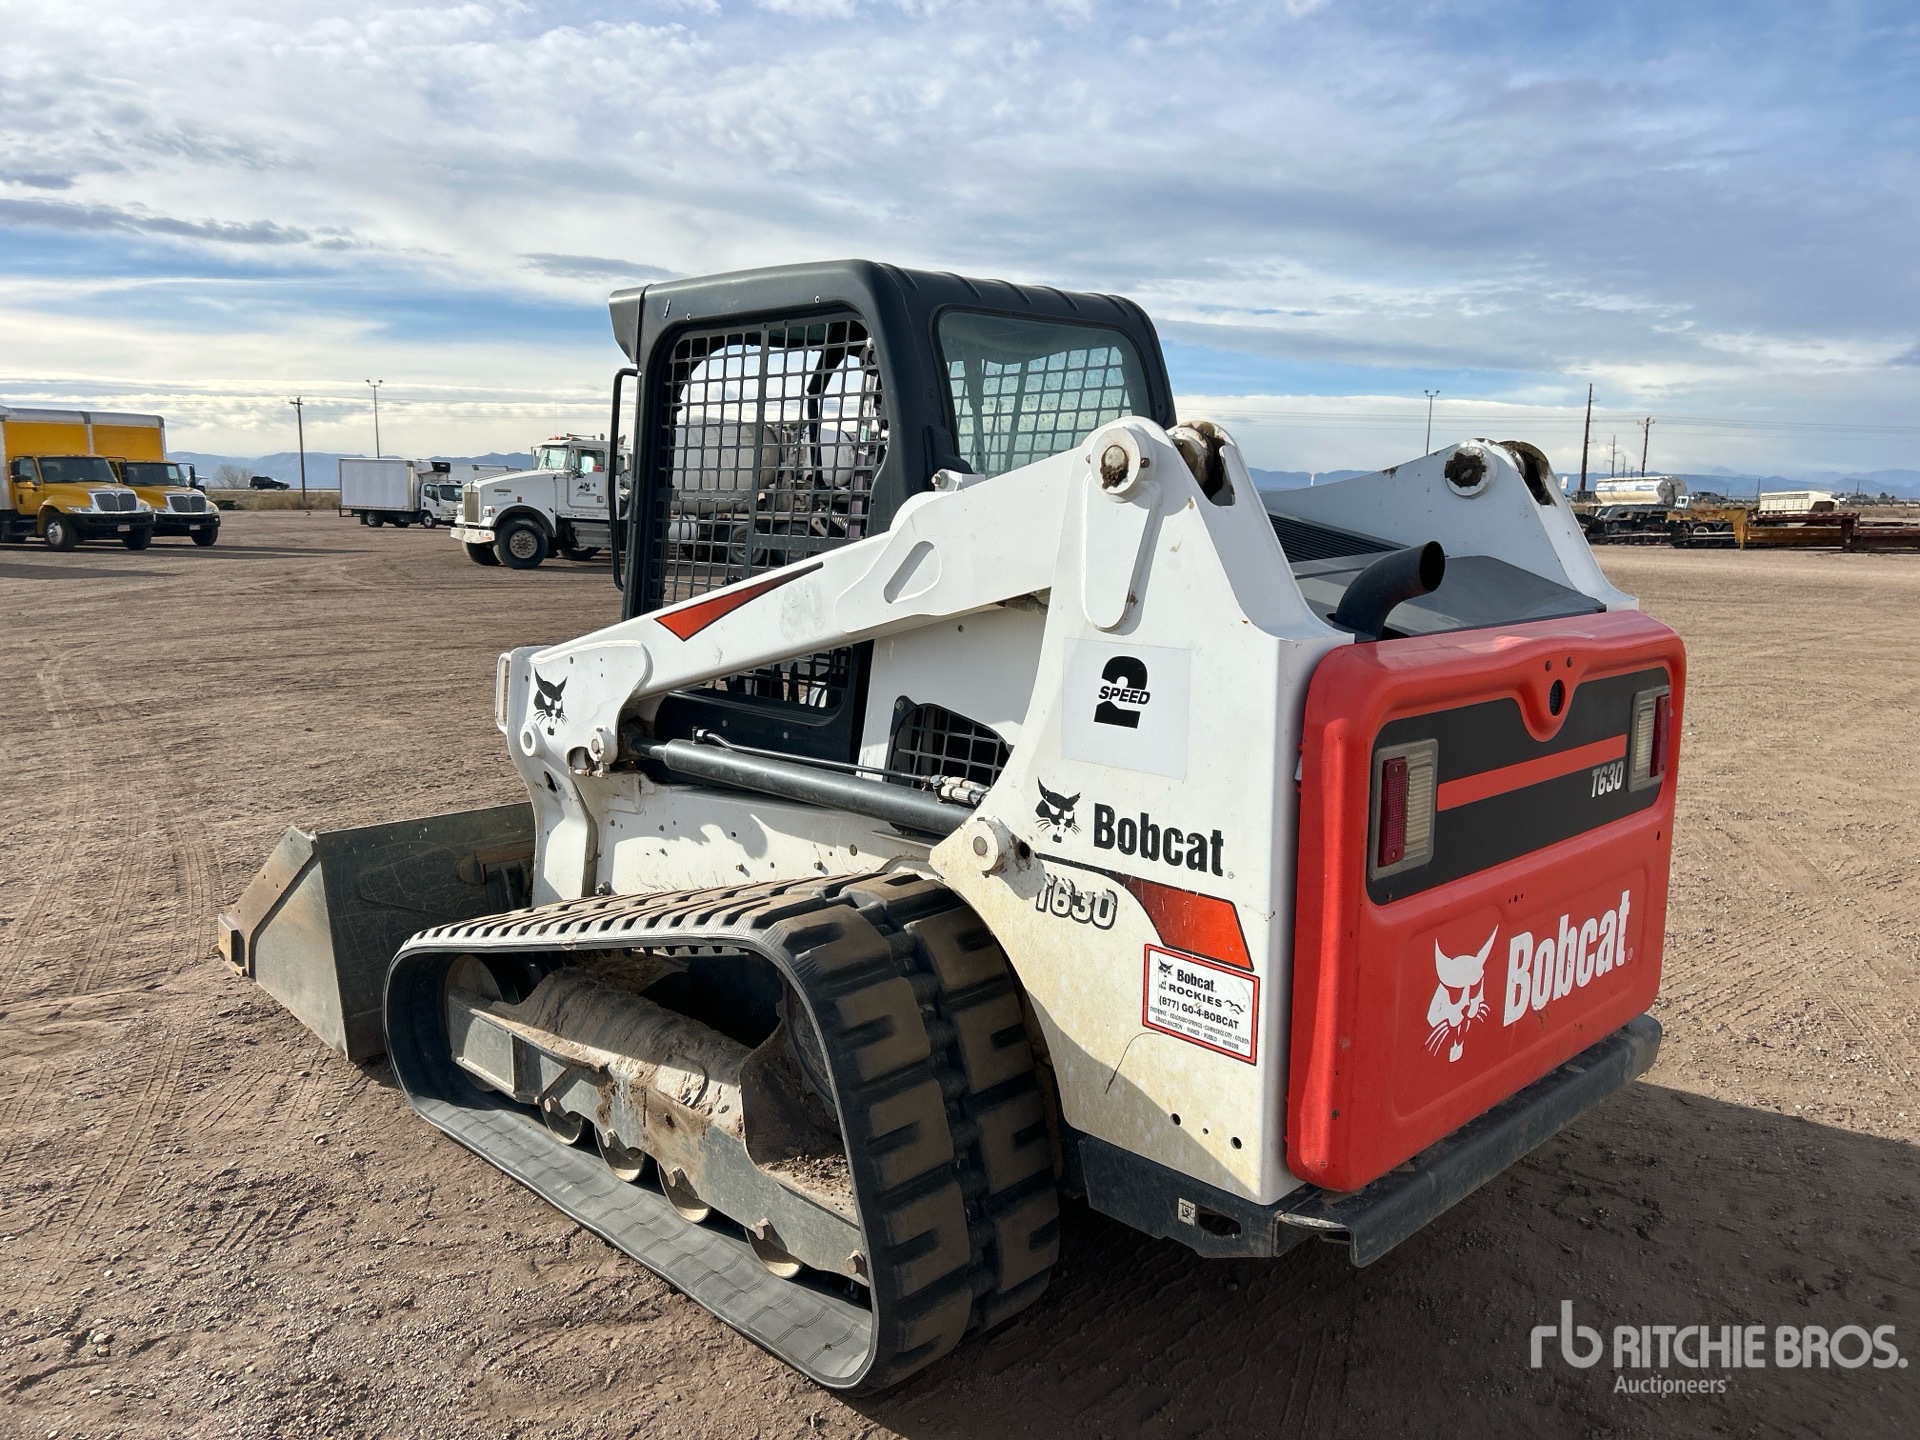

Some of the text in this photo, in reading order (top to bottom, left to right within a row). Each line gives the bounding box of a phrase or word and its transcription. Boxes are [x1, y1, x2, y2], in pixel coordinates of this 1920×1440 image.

[1094, 655, 1148, 729] 2
[1098, 685, 1151, 705] SPEED
[1590, 760, 1624, 798] T630
[1094, 802, 1224, 877] Bobcat
[1503, 890, 1631, 1027] Bobcat
[1168, 983, 1223, 1008] ROCKIES
[1177, 968, 1214, 992] Bobcat
[1159, 995, 1179, 1011] (877)
[1181, 1003, 1239, 1030] GO-4-BOBCAT
